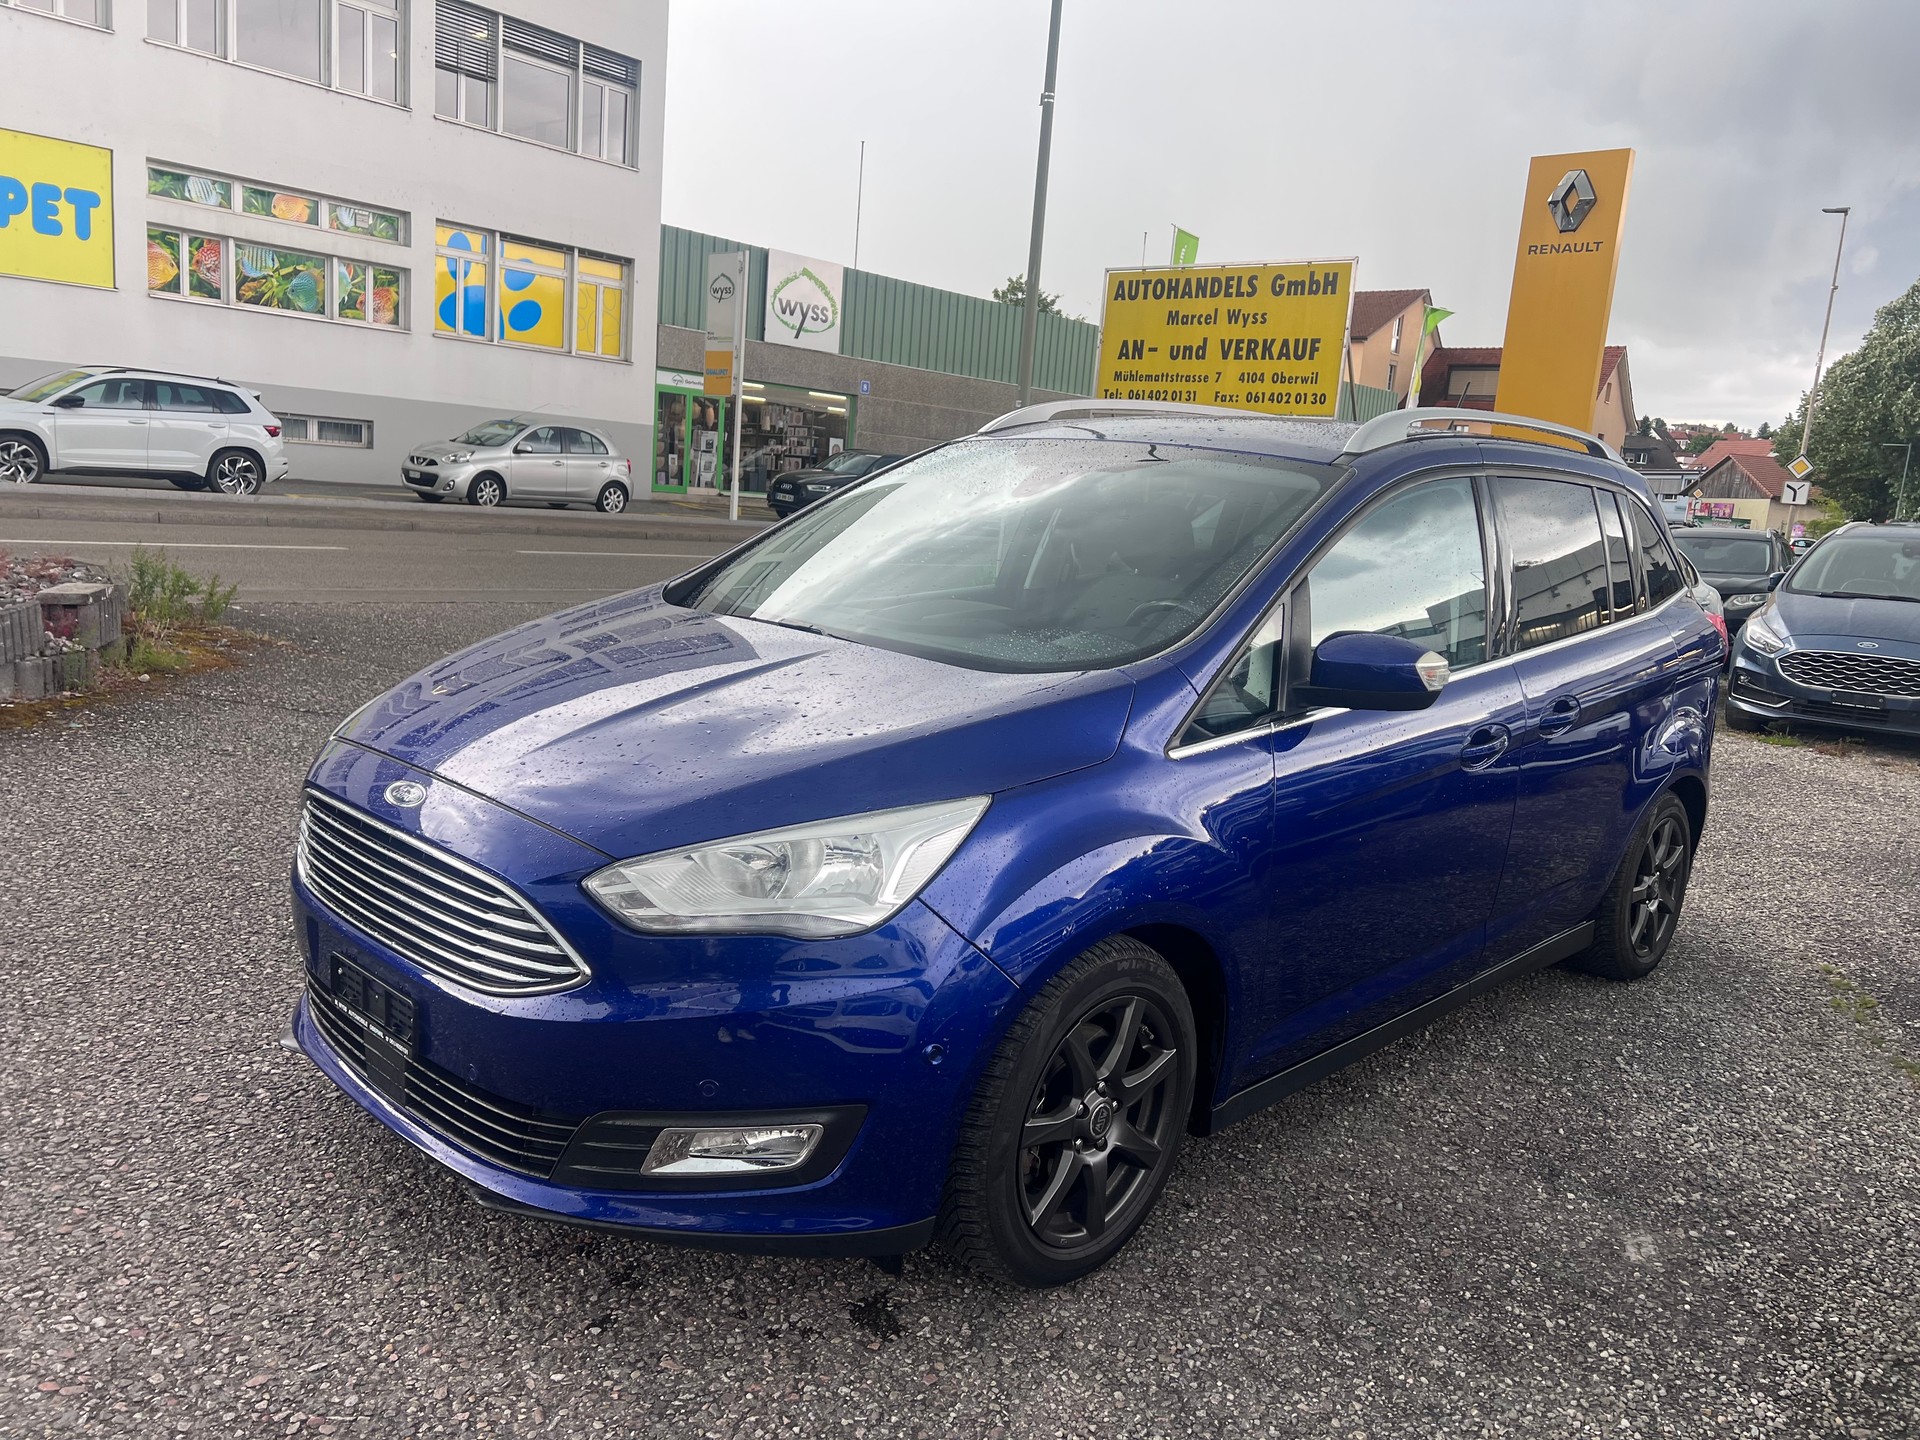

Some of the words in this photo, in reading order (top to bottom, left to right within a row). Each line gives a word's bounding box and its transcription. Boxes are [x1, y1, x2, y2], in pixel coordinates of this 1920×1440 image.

[1527, 241, 1603, 255] RENAULT
[712, 286, 732, 303] wyss
[1113, 274, 1259, 301] AUTOHANDELS
[1270, 270, 1339, 297] GmbH
[778, 297, 829, 339] wyss
[1166, 308, 1218, 326] Marcel
[1227, 309, 1268, 328] Wyss
[1169, 337, 1208, 361] und
[1220, 338, 1322, 361] VERKAUF
[1113, 370, 1210, 383] Mühlemattstrasse
[1215, 371, 1222, 383] 7
[1238, 372, 1265, 384] 4104
[1271, 371, 1319, 385] Oberwil
[1103, 388, 1123, 400] Tel:
[1214, 391, 1239, 403] Fax:
